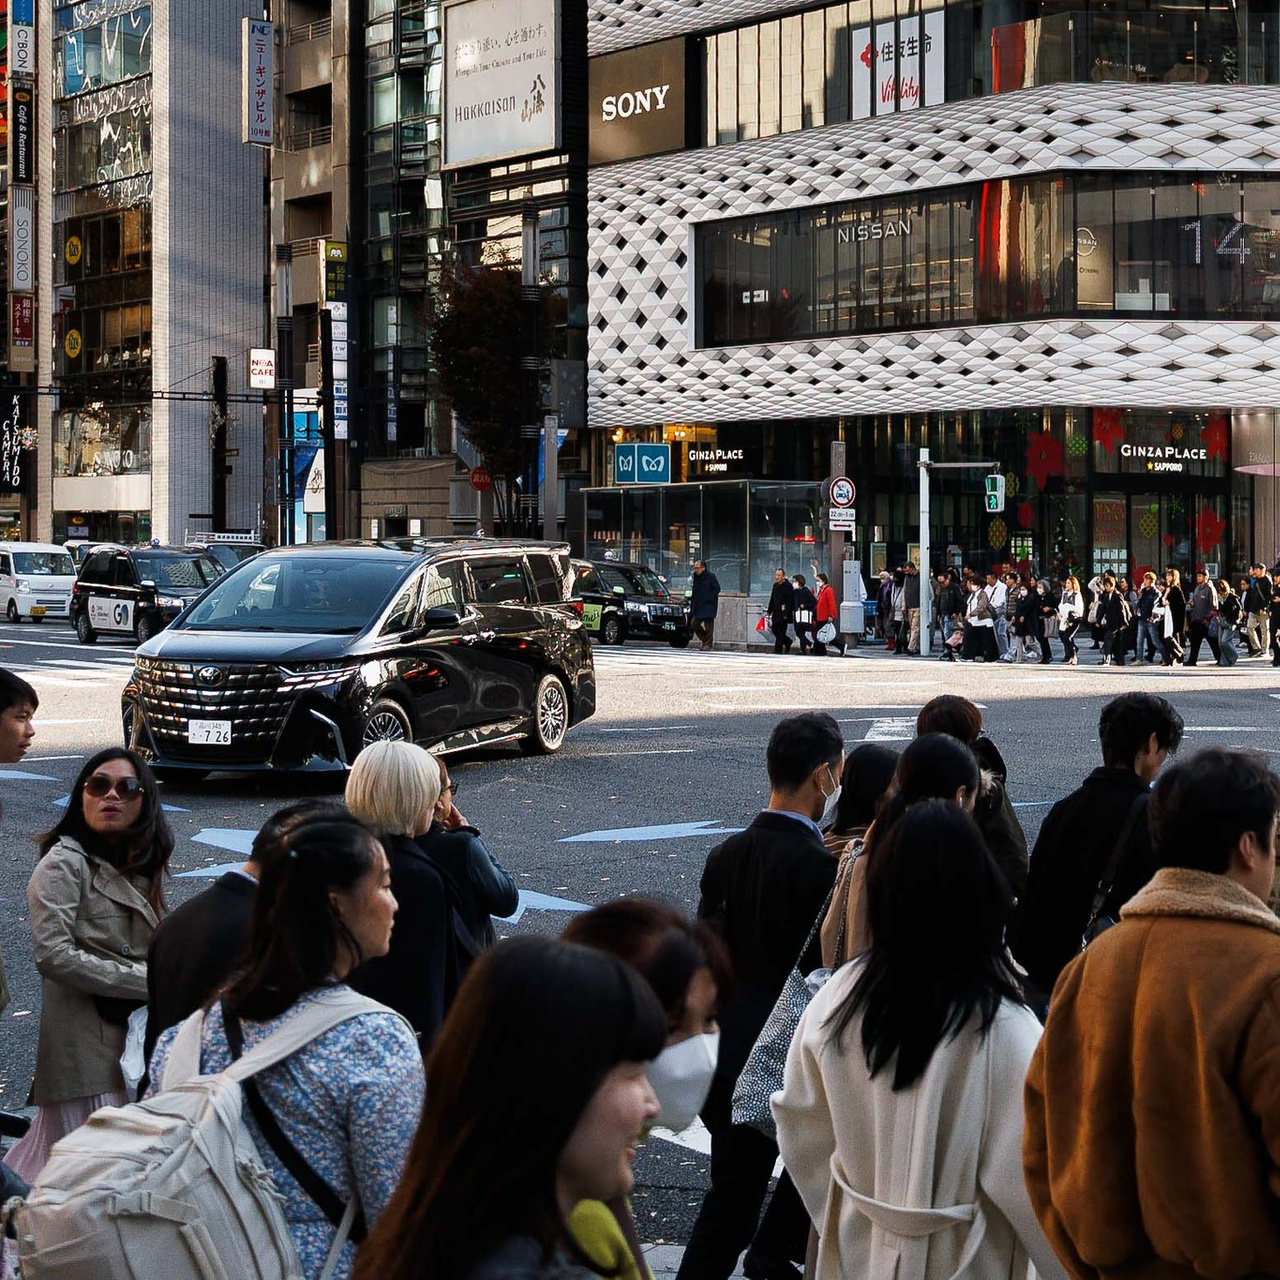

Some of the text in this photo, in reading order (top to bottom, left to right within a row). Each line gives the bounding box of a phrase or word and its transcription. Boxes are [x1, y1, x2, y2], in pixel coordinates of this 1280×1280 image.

[17, 29, 28, 69] C'BON
[522, 51, 535, 62] Your
[255, 39, 267, 124] ニューギンザビル
[881, 74, 920, 106] Vitlity
[602, 84, 670, 122] SONY
[18, 133, 27, 178] Restaurant
[838, 219, 912, 244] NISSAN
[17, 219, 29, 282] SONOKO
[14, 303, 22, 335] ステーキ
[251, 368, 274, 377] CAFE
[2, 420, 11, 483] CAMERA
[12, 394, 20, 487] KATSUMIDO
[689, 449, 744, 461] GINZA PLACE
[1120, 444, 1207, 460] GINZA PLACE
[1154, 462, 1183, 472] SAPPORO
